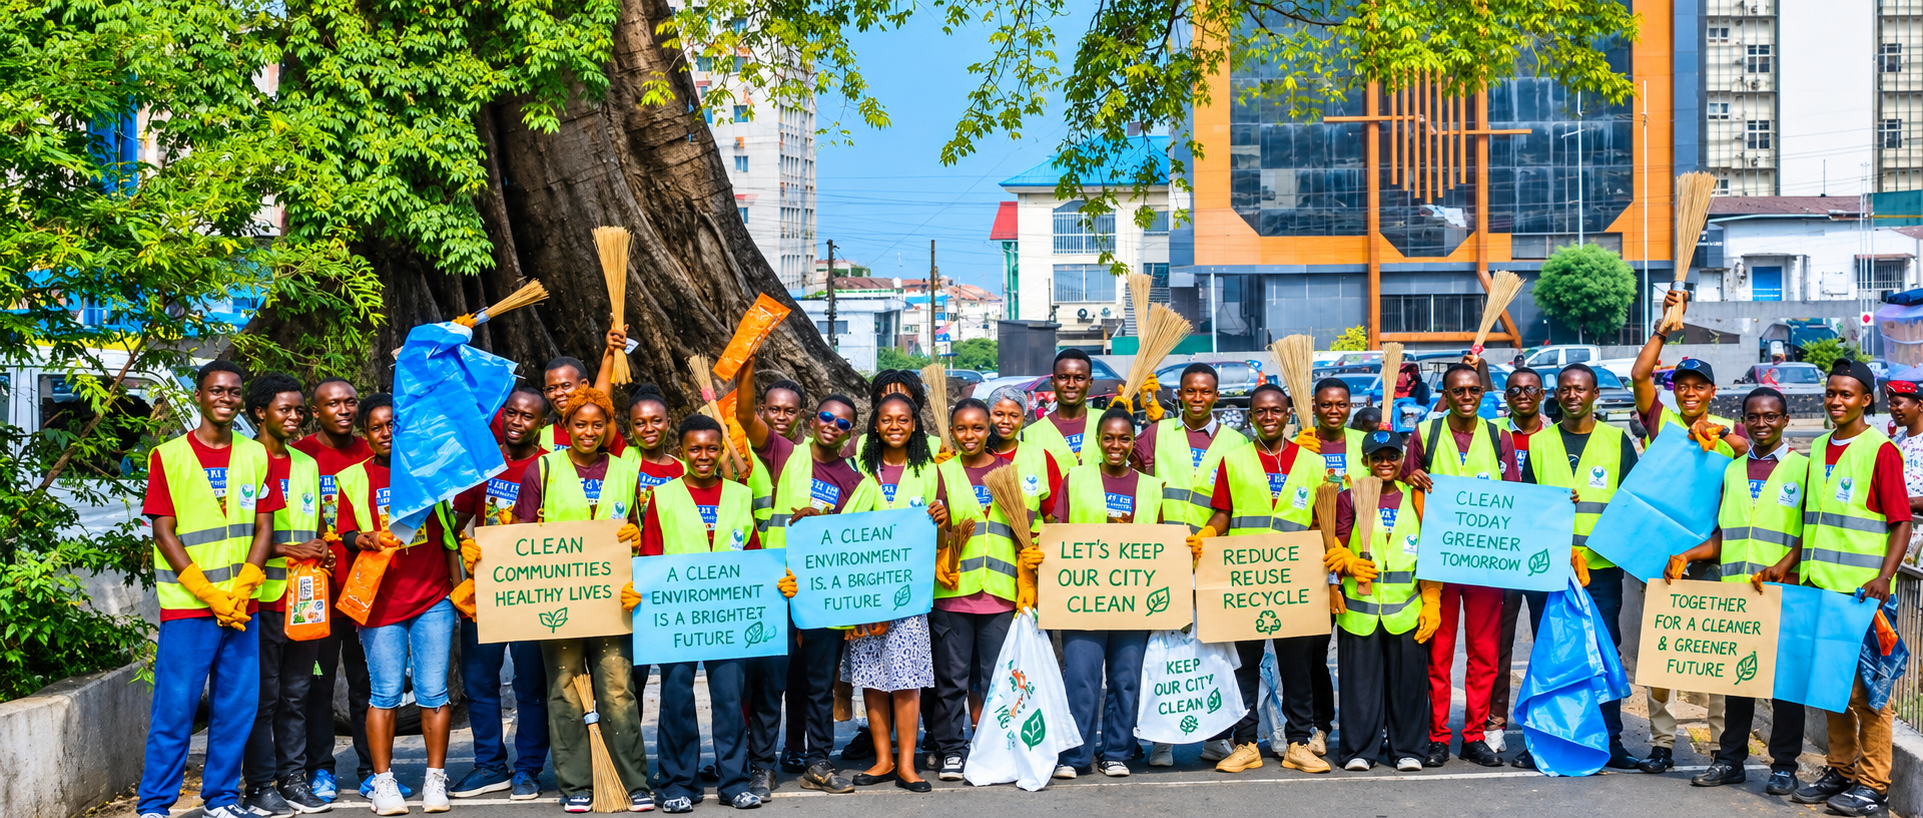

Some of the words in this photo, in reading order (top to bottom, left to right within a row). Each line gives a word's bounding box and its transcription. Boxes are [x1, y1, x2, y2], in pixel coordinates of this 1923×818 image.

[1456, 491, 1514, 509] CLEAN
[1455, 512, 1511, 530] TODAY
[515, 536, 583, 556] CLEAN
[821, 529, 832, 545] A
[1442, 531, 1521, 551] GREENER
[1061, 539, 1109, 559] LET'S
[1120, 542, 1164, 559] KEEP
[1224, 546, 1299, 565] REDUCE
[806, 548, 912, 569] ENVIRONMENT
[1440, 552, 1521, 571] TOMORROW
[493, 561, 611, 582] COMMUNITIES
[666, 567, 678, 582] A
[686, 564, 740, 581] CLEAN
[1058, 569, 1099, 587] OUR
[1109, 569, 1156, 587] CITY
[1231, 568, 1291, 586] REUSE
[832, 575, 841, 589] A
[495, 588, 563, 607] HEALTHY
[569, 585, 612, 601] LIVES
[824, 594, 881, 610] FUTURE
[1067, 595, 1135, 613] CLEAN
[1224, 588, 1309, 609] RECYCLE
[1670, 594, 1747, 613] TOGETHER
[654, 612, 669, 627] IS
[675, 612, 685, 625] A
[1655, 614, 1681, 630] FOR
[1686, 617, 1696, 631] A
[1702, 618, 1761, 635] CLEANER
[674, 630, 734, 648] FUTURE
[1658, 636, 1667, 651] &
[1675, 638, 1737, 656] GREENER
[1166, 658, 1200, 675] KEEP
[1667, 659, 1725, 677] FUTURE
[1154, 681, 1181, 696] OUR
[1186, 674, 1214, 692] CITY
[1158, 697, 1203, 715] CLEAN
